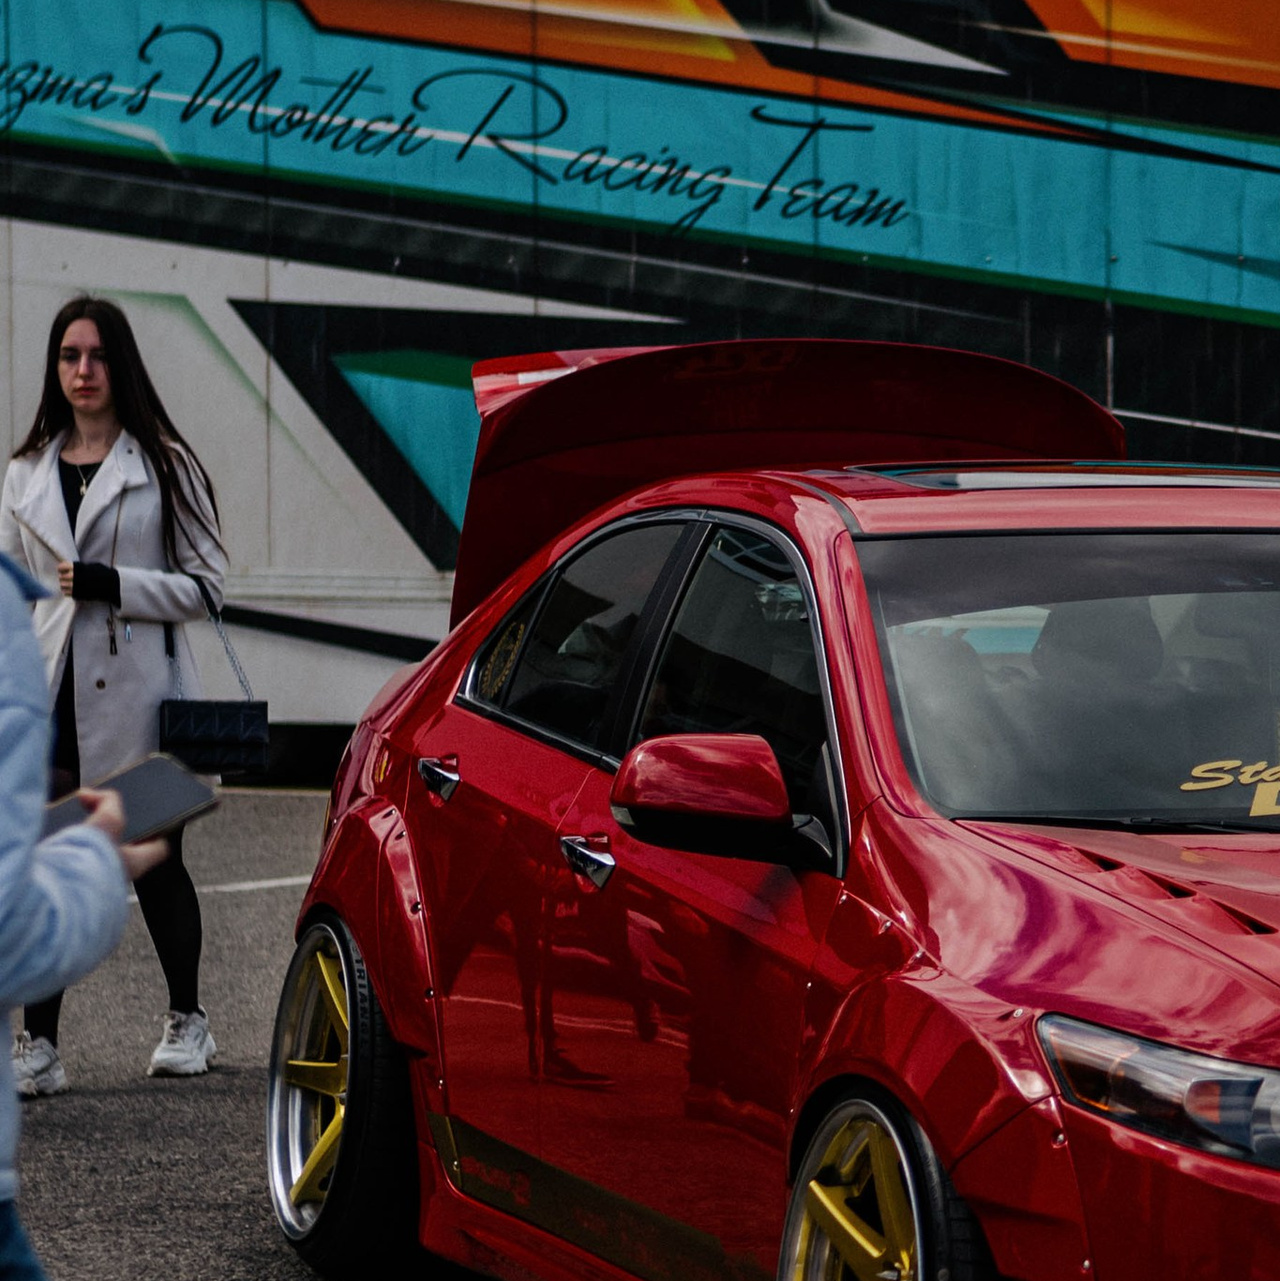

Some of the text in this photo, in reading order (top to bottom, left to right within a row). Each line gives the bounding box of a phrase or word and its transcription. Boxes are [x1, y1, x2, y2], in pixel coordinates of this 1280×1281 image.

[139, 23, 433, 158] Mother
[412, 69, 726, 234] Racing
[750, 104, 916, 228] Team
